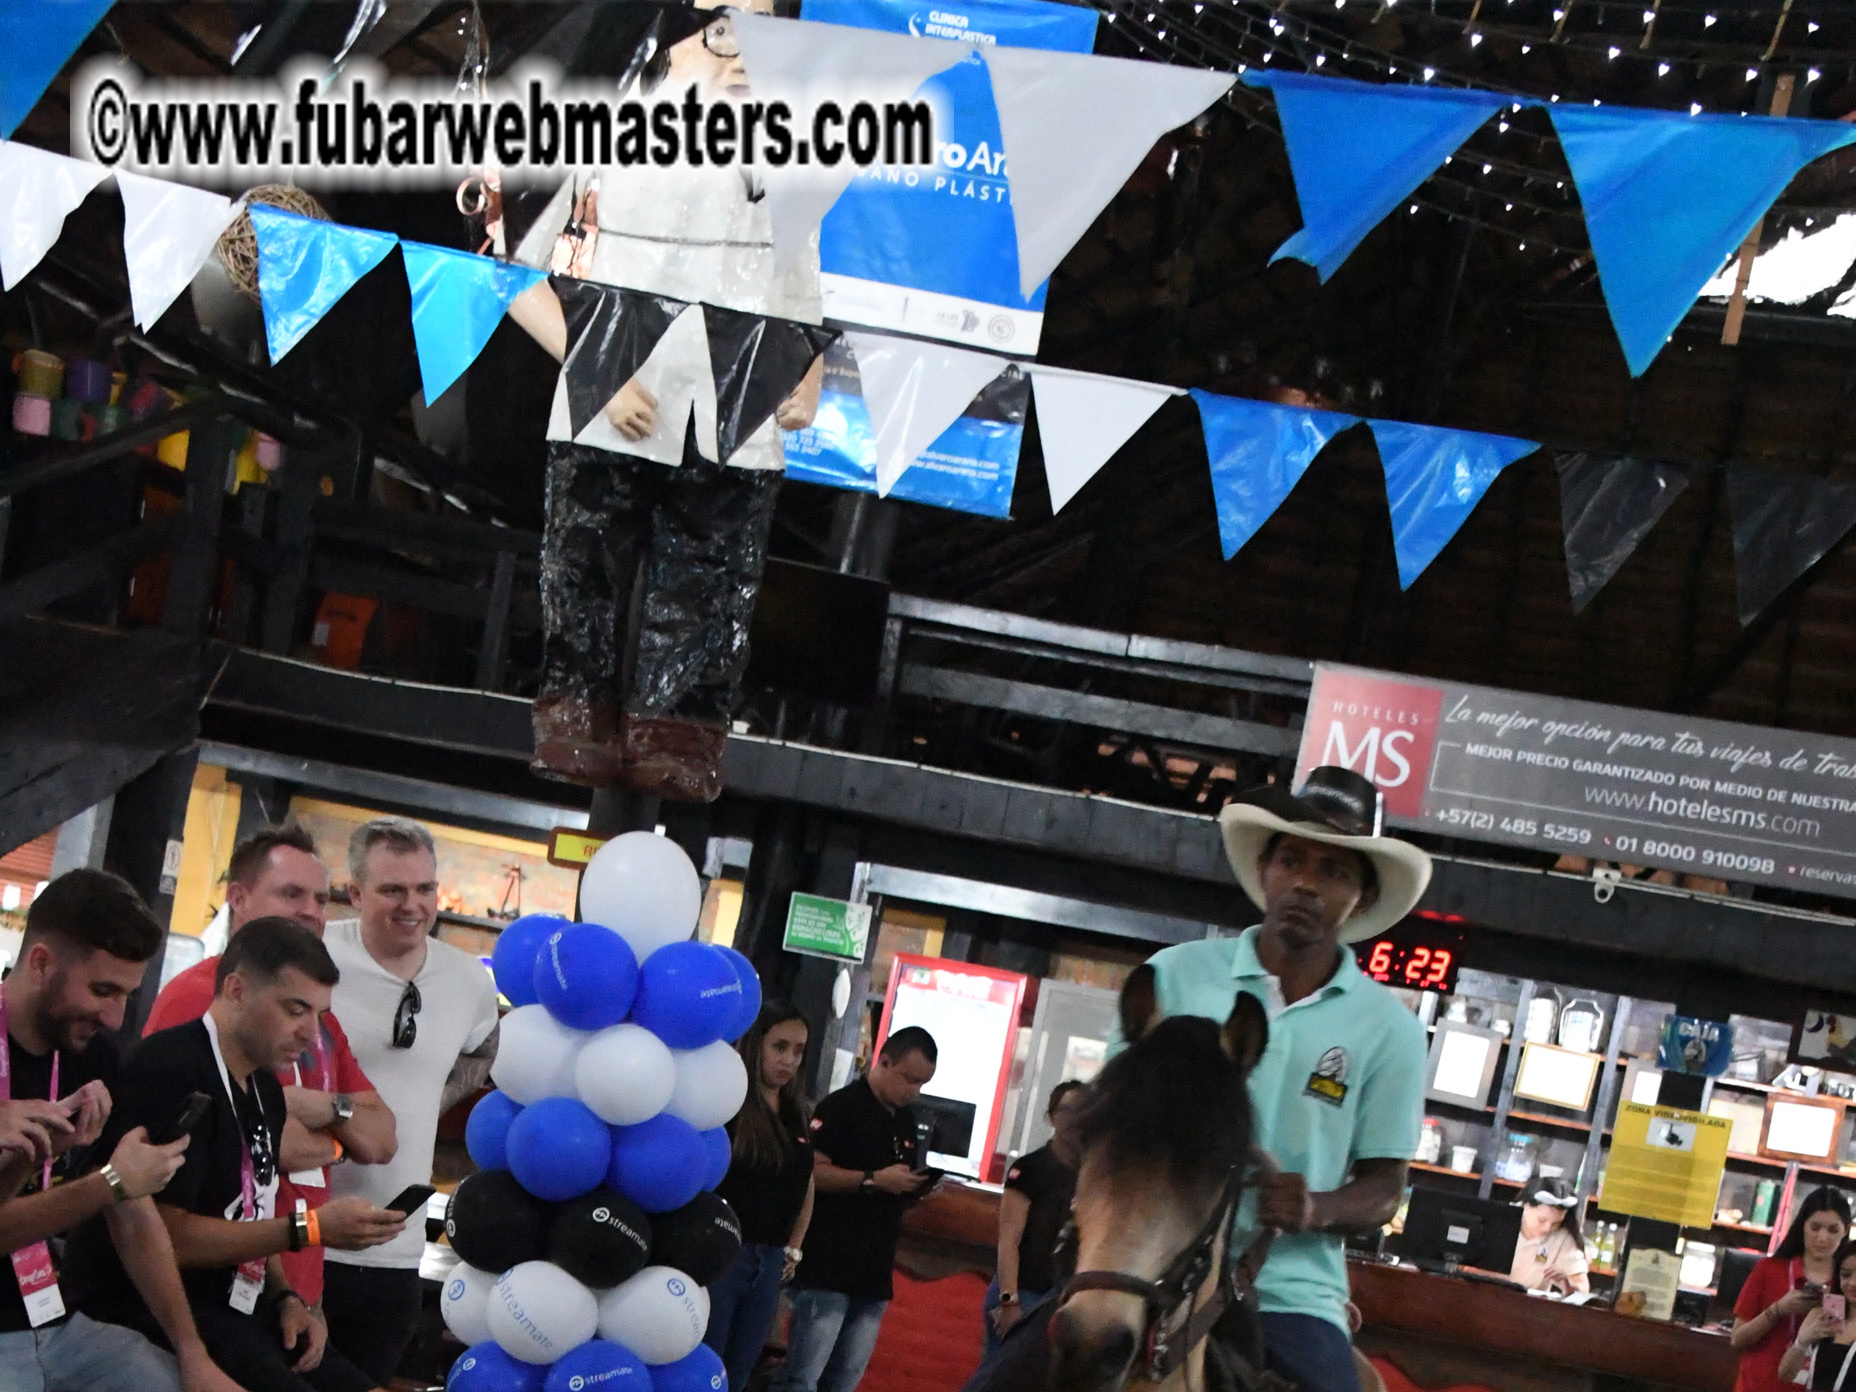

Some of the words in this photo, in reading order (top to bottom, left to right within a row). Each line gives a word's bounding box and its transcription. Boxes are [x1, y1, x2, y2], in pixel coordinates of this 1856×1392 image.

[935, 176, 1014, 206] PLÁST
[1333, 701, 1420, 725] HOTELES
[1444, 694, 1472, 723] La
[1476, 710, 1539, 737] mejor
[1542, 720, 1612, 745] opción
[1607, 727, 1667, 755] para
[1670, 731, 1705, 757] tus
[1710, 743, 1773, 773] viajes
[1779, 749, 1808, 771] de
[1320, 720, 1414, 787] MS
[1465, 742, 1513, 761] MEJOR
[1516, 750, 1569, 770] PRECIO
[1572, 759, 1676, 786] GARANTIZADO
[1679, 775, 1710, 791] POR
[1714, 781, 1763, 799] MEDIO
[1766, 788, 1787, 803] DE
[1791, 792, 1856, 813] NUESTRA
[1585, 786, 1821, 837] www.hotelesms.com
[1435, 807, 1495, 830] +57(2)
[1500, 817, 1538, 836] 485
[1543, 823, 1592, 845] 5259
[1615, 835, 1638, 852] 01
[1642, 840, 1696, 861] 8000
[1702, 849, 1776, 875] 910098
[1369, 941, 1452, 983] 6:23
[1625, 1104, 1651, 1115] ZONA
[608, 1215, 649, 1252] streamate
[500, 1282, 553, 1350] streamate
[585, 1366, 633, 1385] streamate
